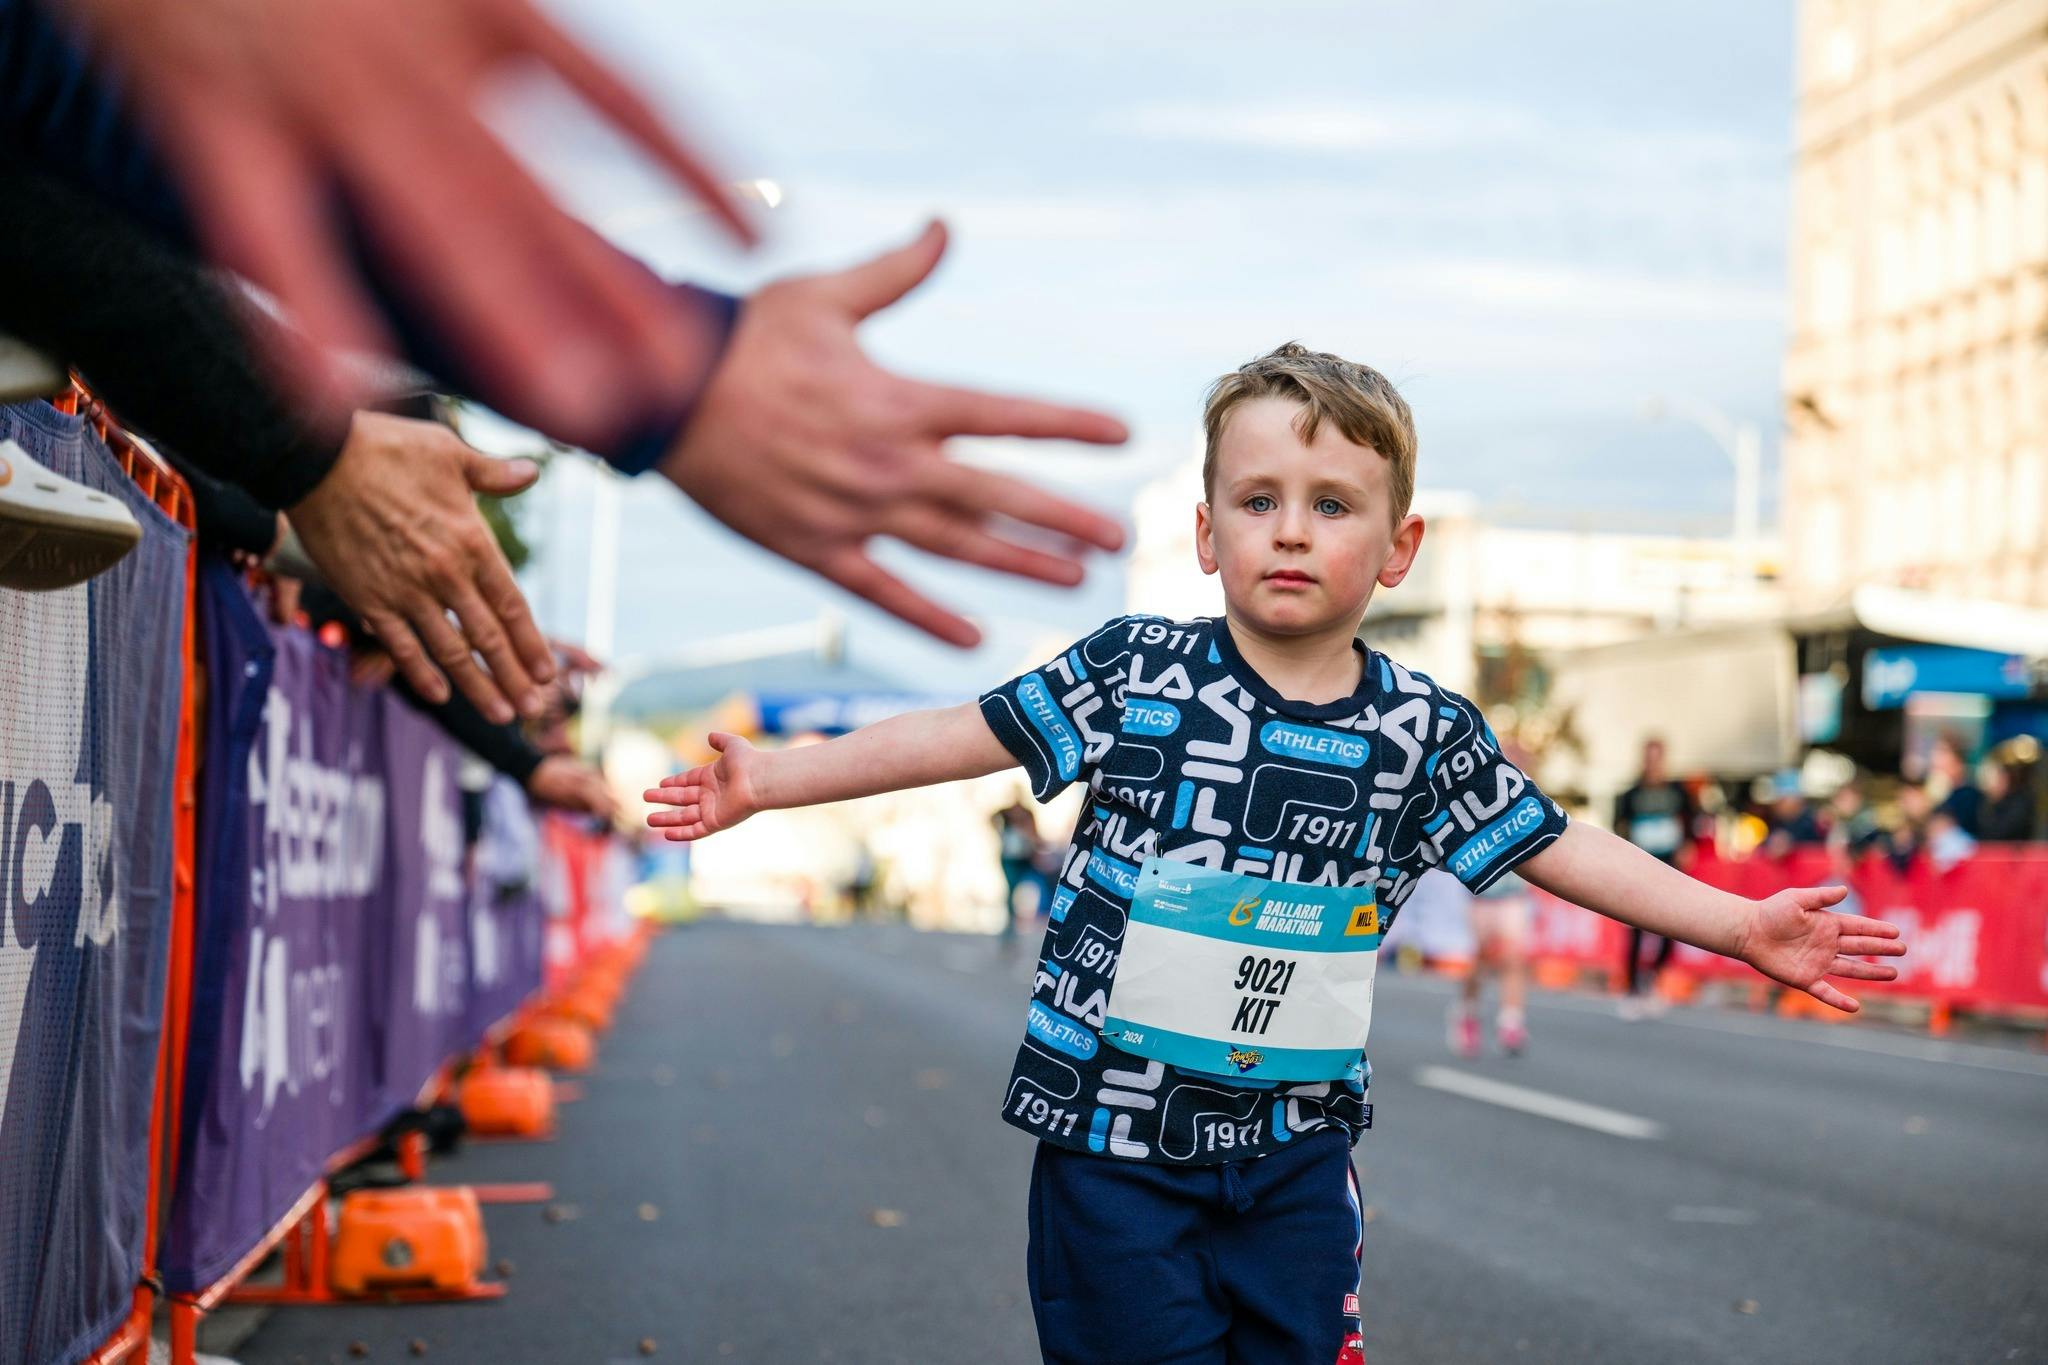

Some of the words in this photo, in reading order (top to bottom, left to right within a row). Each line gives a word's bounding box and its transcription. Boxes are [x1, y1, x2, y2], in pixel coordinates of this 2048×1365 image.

[1127, 623, 1200, 655] 1911
[1045, 649, 1115, 763] FILA
[1023, 681, 1076, 774] ATHLETICS
[1268, 728, 1364, 760] ATHLETICS
[1437, 731, 1496, 790] 1911
[1423, 763, 1526, 856] FILA
[1287, 813, 1357, 850] 1911
[1454, 801, 1540, 876] ATHLETICS
[1255, 915, 1324, 937] MARATHON
[1262, 900, 1326, 921] BALLARAT
[1356, 911, 1372, 928] MILE
[1234, 955, 1297, 995] 9021
[1028, 1007, 1093, 1052] ATHLETICS
[1231, 996, 1281, 1035] KIT
[1122, 1031, 1144, 1045] 2024
[1013, 1092, 1079, 1137] 1911
[1204, 1119, 1264, 1152] 1911
